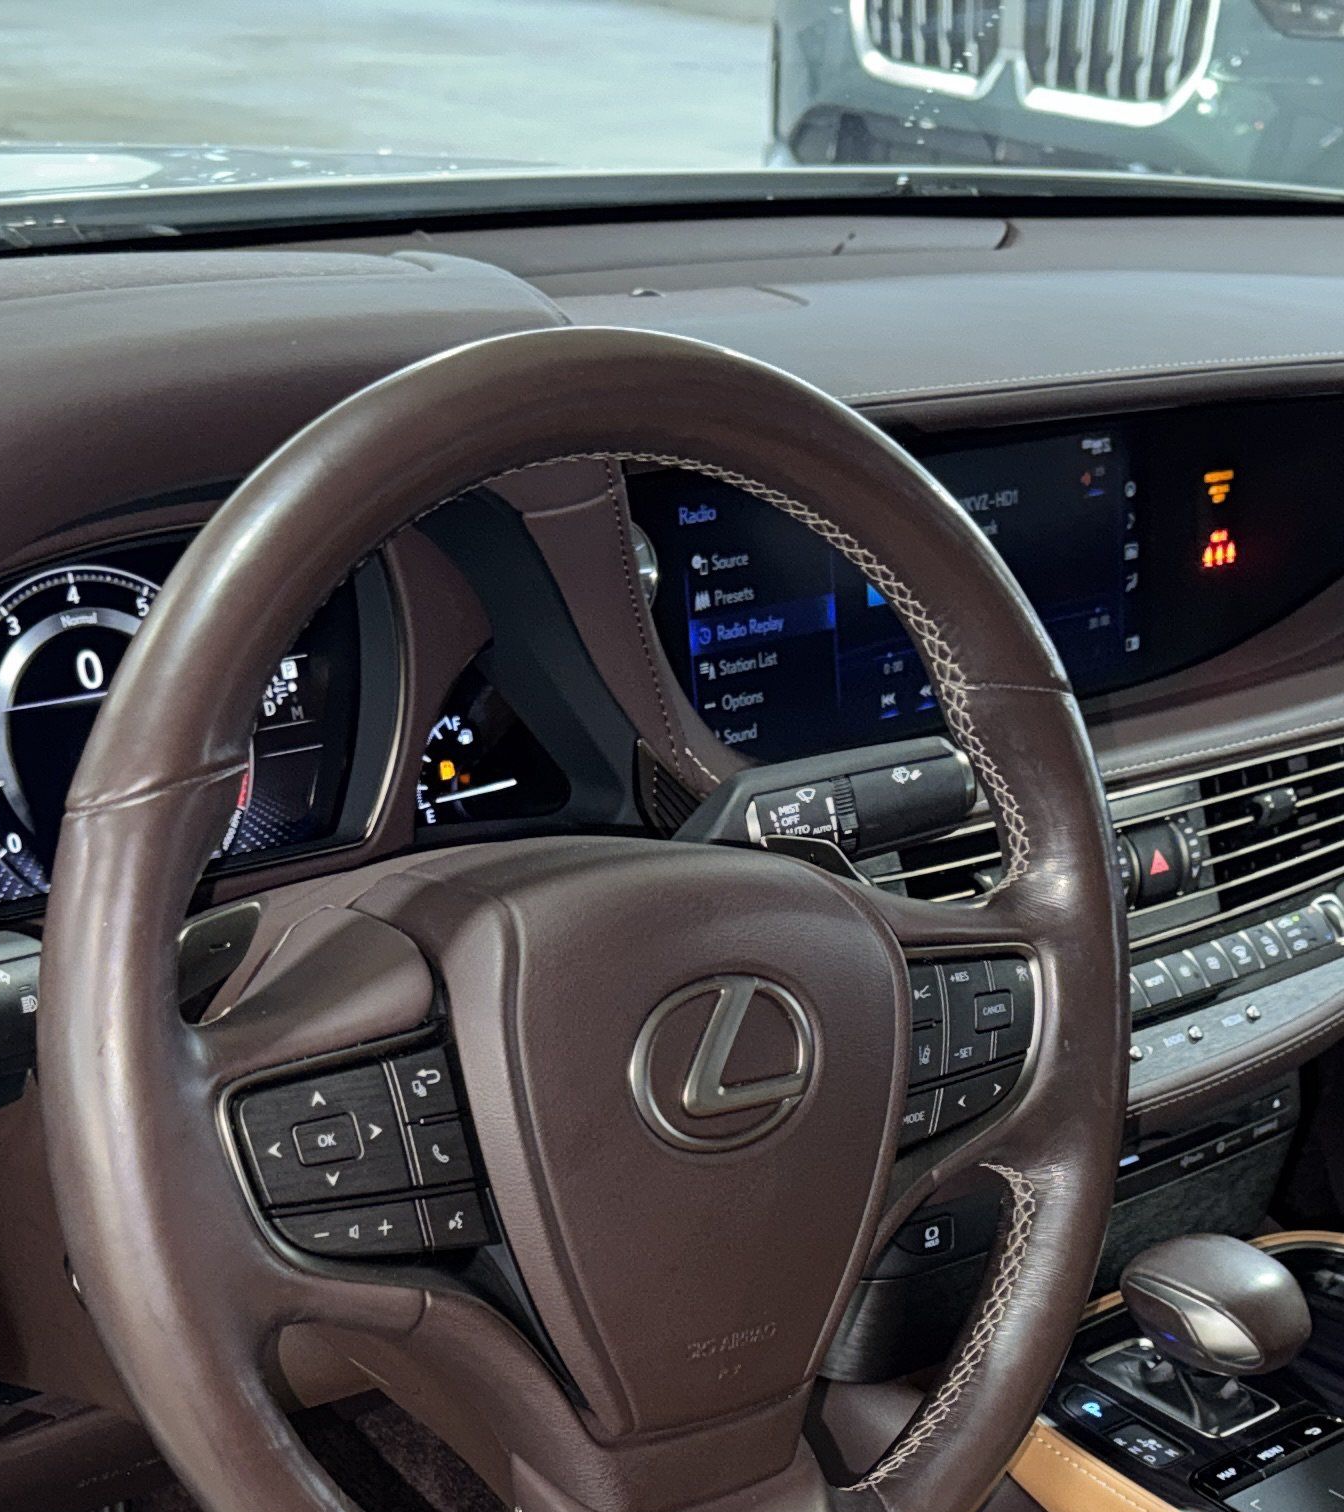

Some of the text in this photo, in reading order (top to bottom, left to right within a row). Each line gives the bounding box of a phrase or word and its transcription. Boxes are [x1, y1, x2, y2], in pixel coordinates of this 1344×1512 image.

[678, 505, 716, 526] Radio
[711, 553, 749, 570] Source
[67, 586, 80, 604] 4
[714, 588, 754, 604] Presets
[136, 598, 151, 616] 5
[6, 617, 21, 635] 3
[60, 612, 97, 626] Normal
[717, 616, 784, 641] Radio Replay
[76, 649, 103, 688] 0
[719, 652, 778, 677] Station List
[264, 701, 276, 716] D
[722, 691, 764, 711] Options
[724, 724, 758, 744] Sound
[778, 803, 800, 816] MIST
[781, 814, 800, 826] OFF
[7, 834, 22, 852] 0
[982, 1003, 1007, 1017] CANCEL
[317, 1133, 337, 1148] OK
[1082, 1402, 1103, 1418] P
